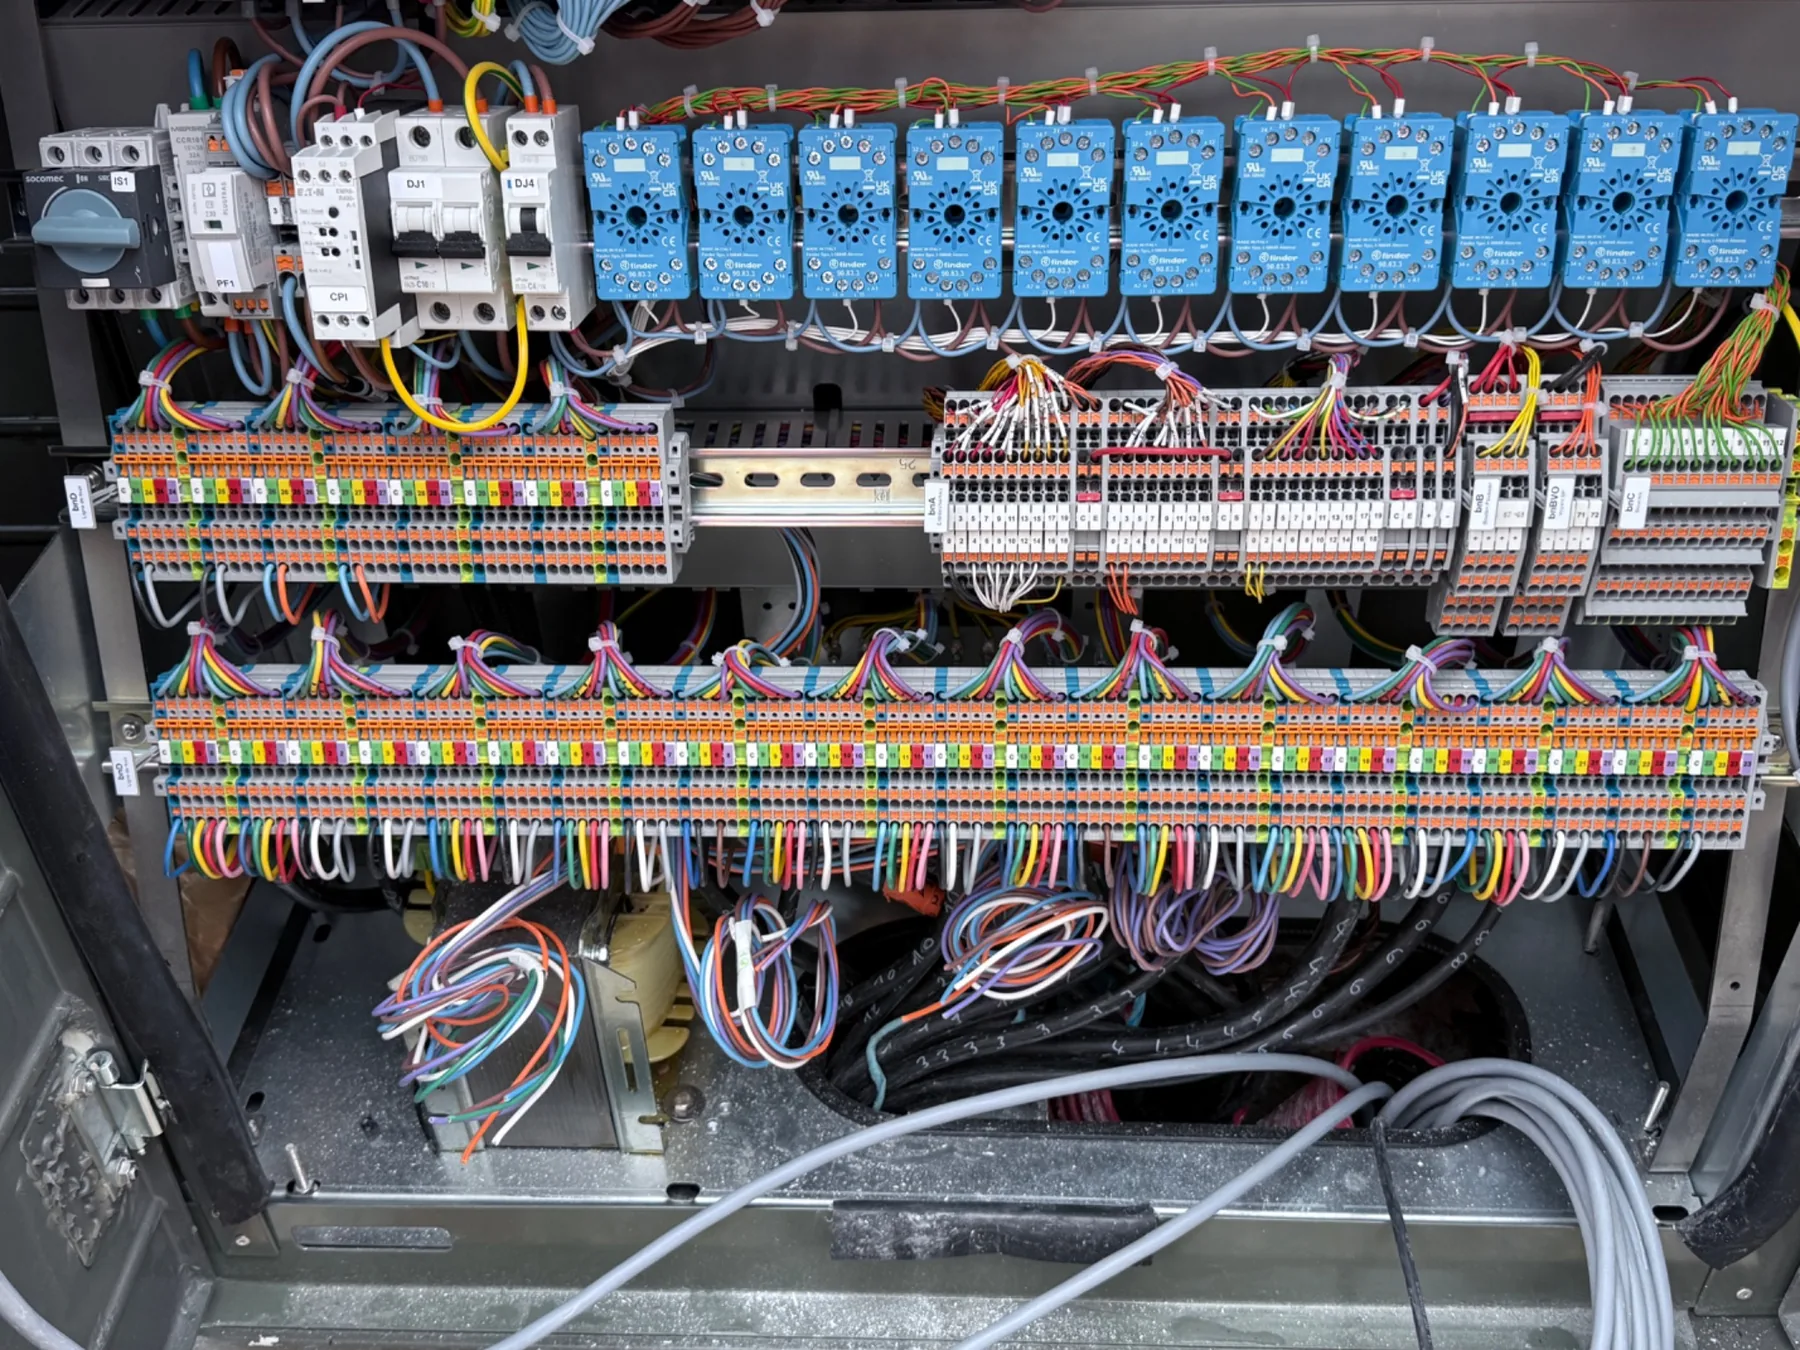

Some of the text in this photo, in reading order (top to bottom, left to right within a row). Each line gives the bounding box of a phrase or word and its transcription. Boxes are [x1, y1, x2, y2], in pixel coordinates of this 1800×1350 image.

[1545, 168, 1559, 176] UK
[25, 175, 64, 183] socomec
[114, 177, 128, 186] IS1
[407, 179, 425, 188] DJ1
[515, 179, 534, 188] DJ4
[1093, 177, 1106, 185] UK
[983, 181, 997, 189] UK
[1494, 249, 1524, 257] finder
[1050, 258, 1079, 266] finder
[1269, 254, 1298, 262] finder
[734, 262, 762, 270] finder
[216, 279, 235, 287] PF1
[330, 293, 348, 301] CPI
[70, 493, 79, 512] bnD
[1474, 494, 1485, 513] bnB
[1548, 486, 1560, 519] bnBVO
[1625, 492, 1636, 512] bnC
[1312, 1003, 1326, 1019] 6
[1349, 978, 1365, 995] 6
[1386, 948, 1404, 964] 6
[1415, 919, 1431, 932] 6
[1436, 891, 1451, 904] 6
[1451, 951, 1468, 969] 8
[1112, 1040, 1125, 1054] 4
[1186, 1035, 1200, 1049] 4
[1223, 1026, 1235, 1038] 4
[916, 1024, 1051, 1069] 3 3 3 3 3
